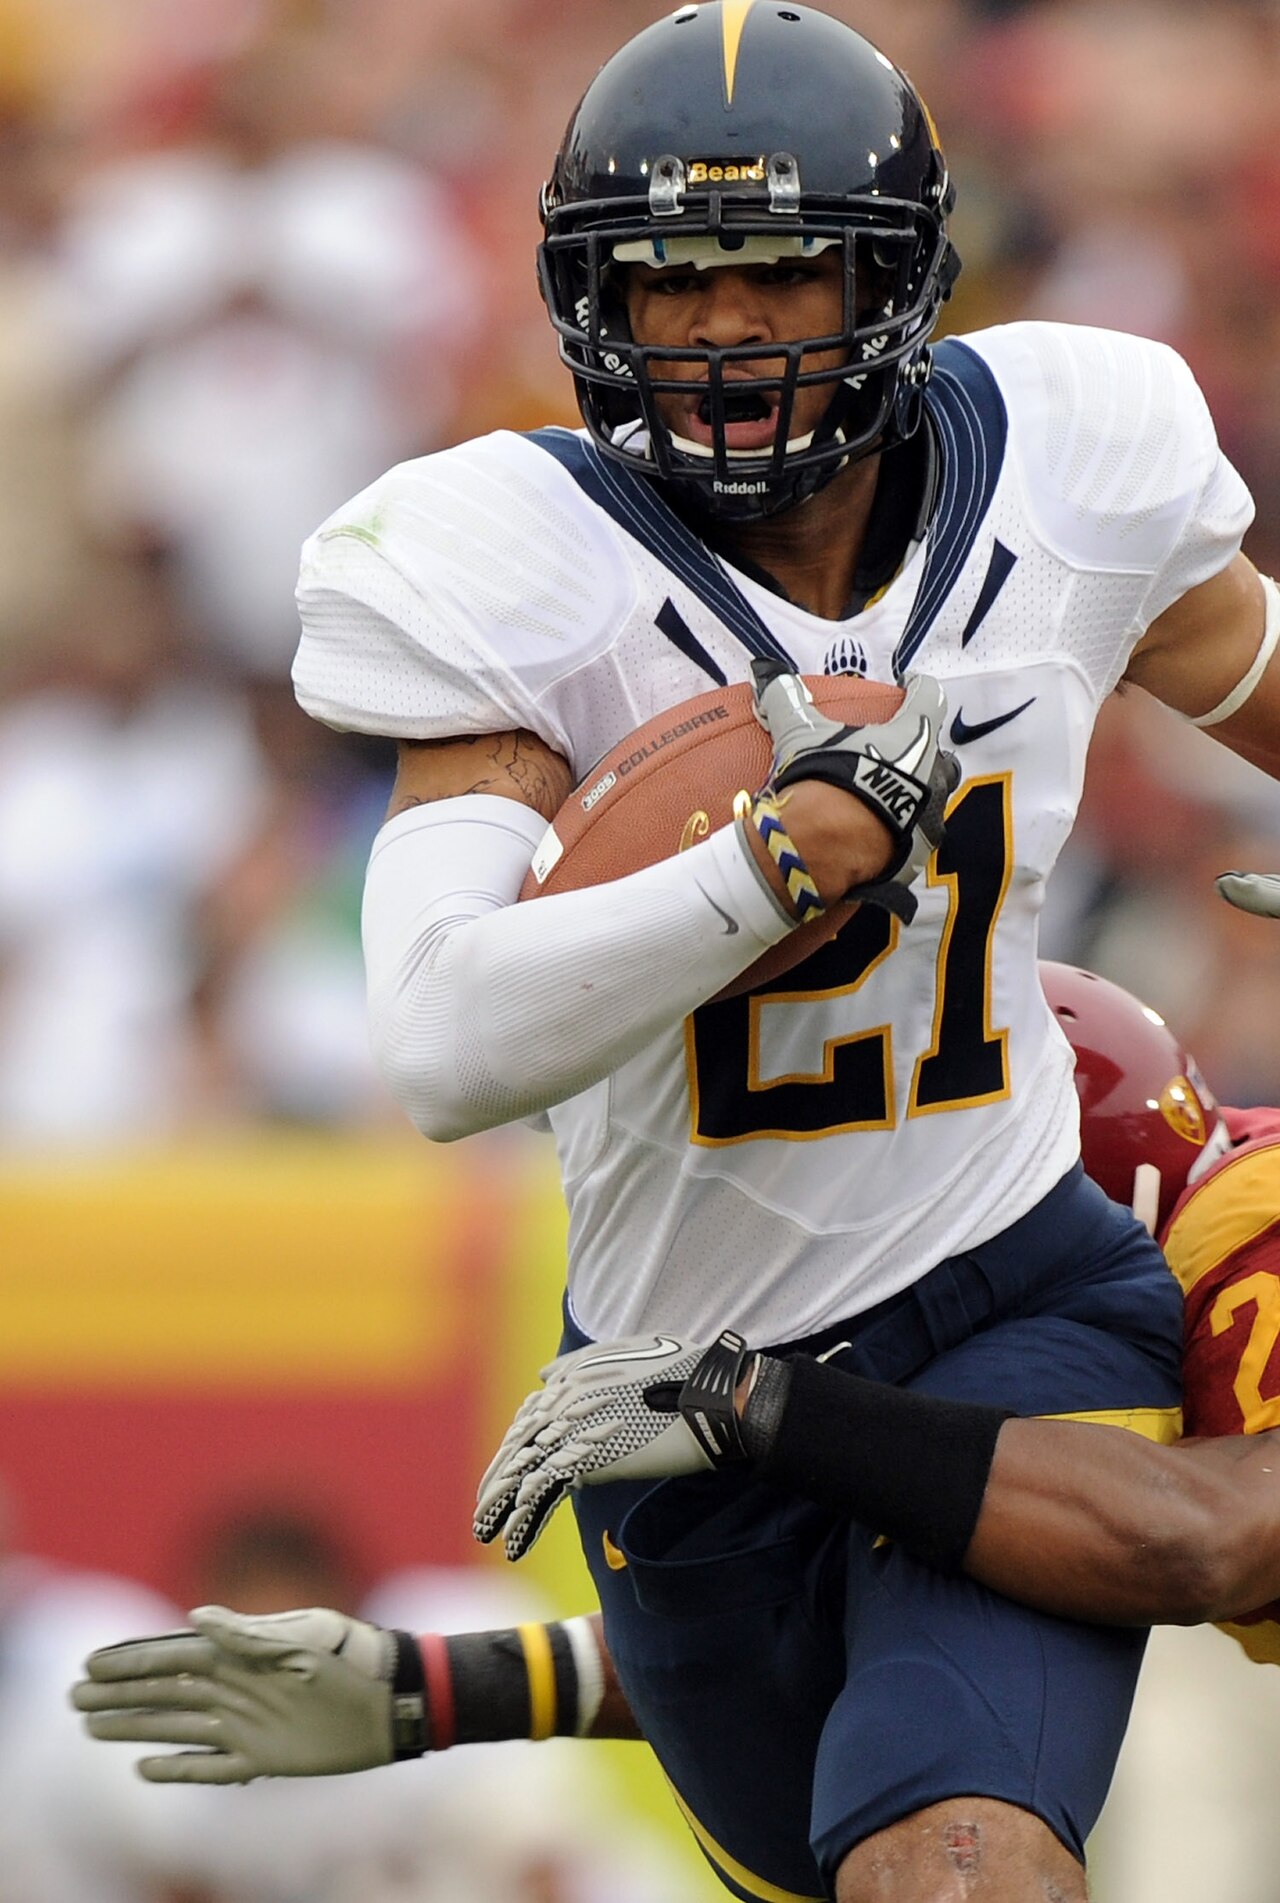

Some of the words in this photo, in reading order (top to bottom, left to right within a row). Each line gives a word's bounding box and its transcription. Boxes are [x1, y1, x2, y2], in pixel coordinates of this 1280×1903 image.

[688, 163, 765, 182] Bears
[617, 705, 729, 776] COLLEGIATE
[860, 765, 918, 821] NIKE
[684, 770, 1015, 1148] 21
